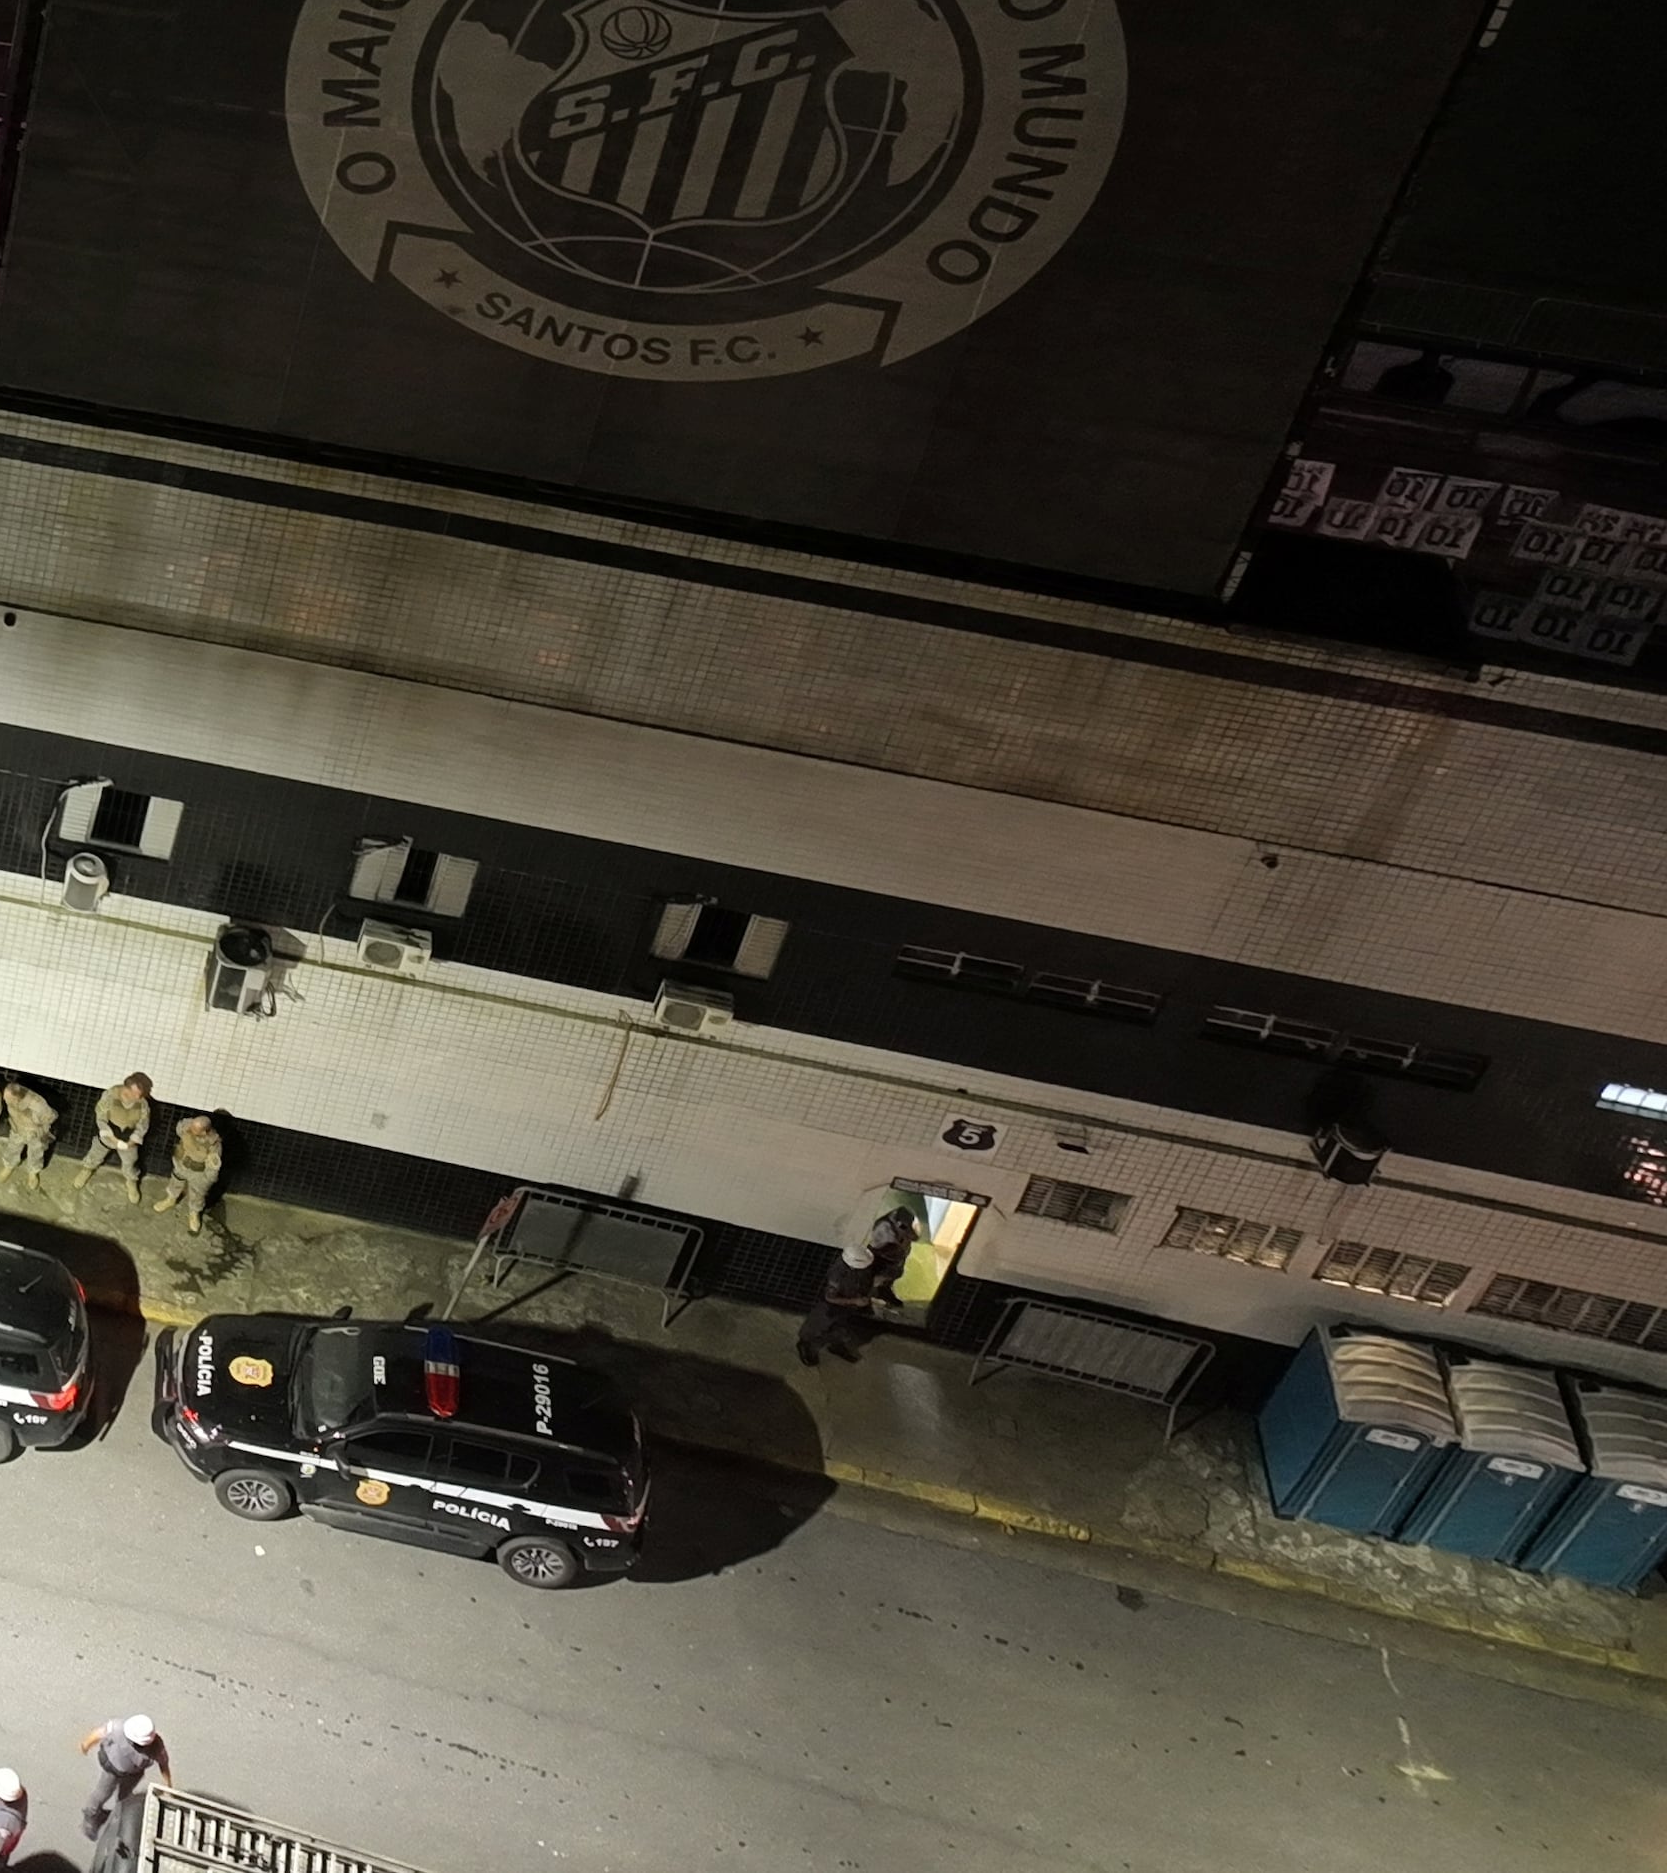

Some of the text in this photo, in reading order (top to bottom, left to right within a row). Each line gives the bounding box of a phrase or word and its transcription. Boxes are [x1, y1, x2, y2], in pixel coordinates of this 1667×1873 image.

[337, 150, 397, 195] O
[925, 42, 1087, 285] MUNDO
[474, 291, 777, 368] SANTOS F.C.
[957, 1128, 983, 1145] 5
[196, 1334, 214, 1397] POLÍCIA
[532, 1363, 554, 1436] P-29016
[432, 1499, 511, 1532] POLÍCIA
